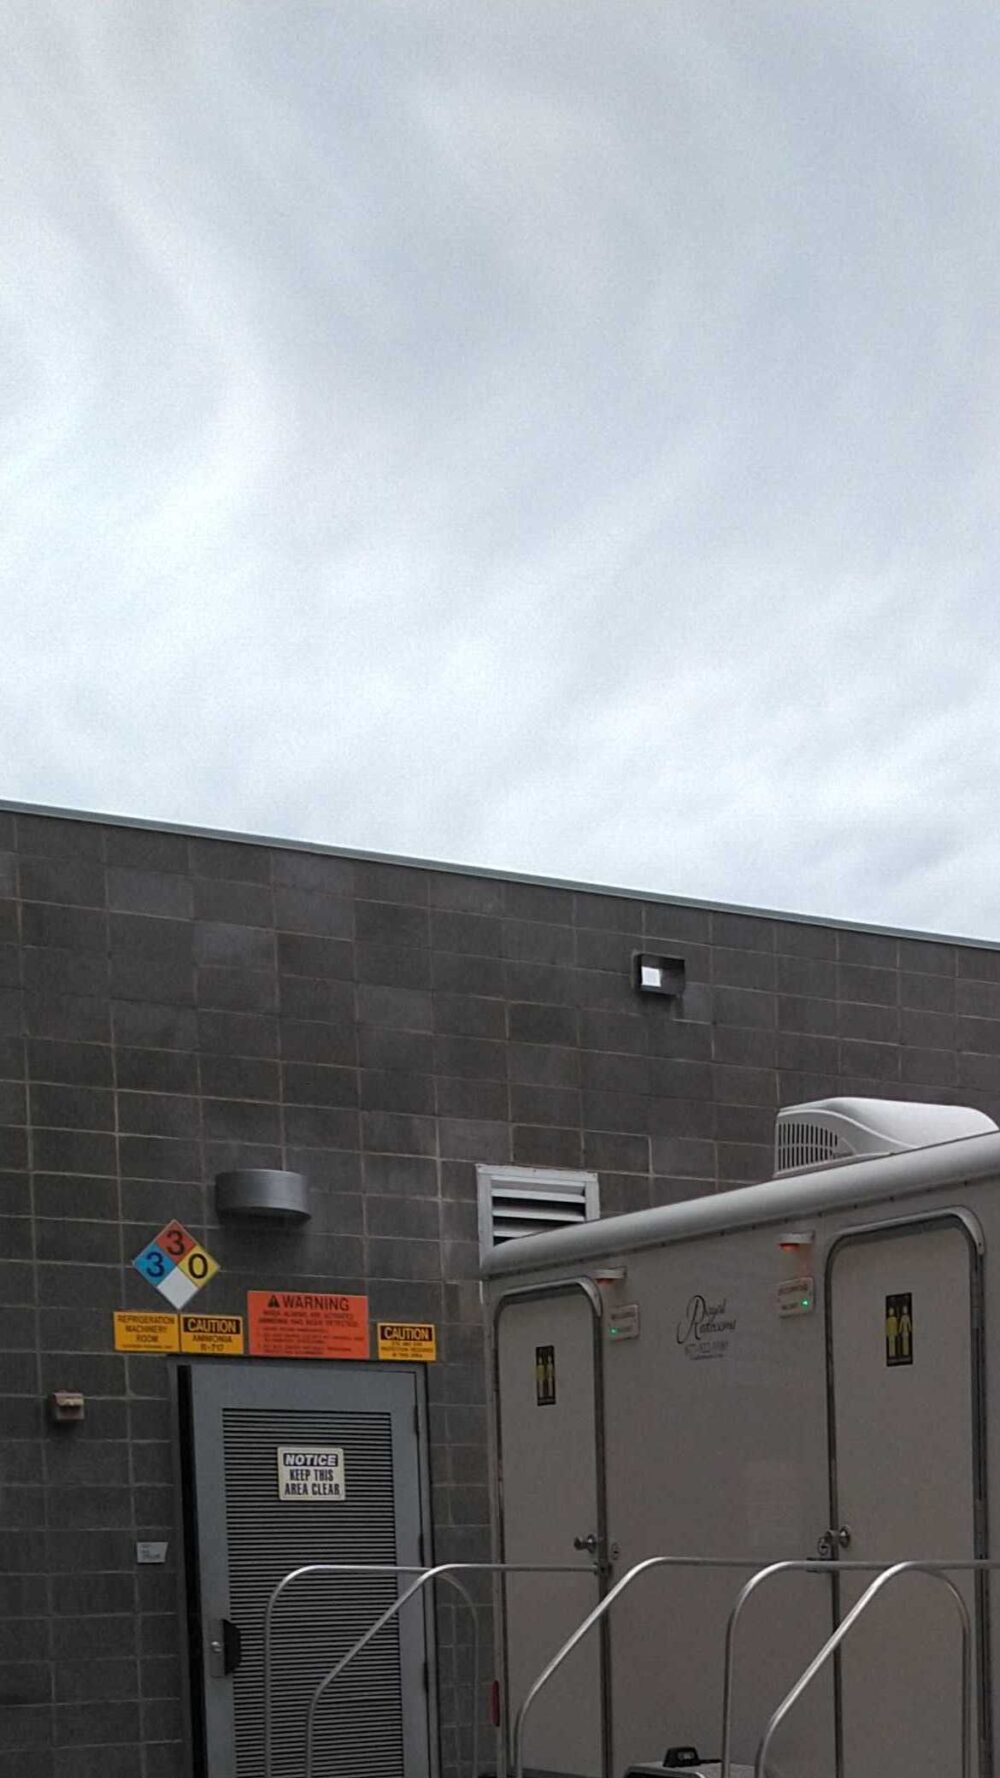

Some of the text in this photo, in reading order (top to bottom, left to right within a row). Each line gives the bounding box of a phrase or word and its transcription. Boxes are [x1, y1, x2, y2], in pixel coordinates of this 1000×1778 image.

[166, 1230, 184, 1255] 3
[147, 1252, 164, 1277] 3
[188, 1253, 208, 1279] 0
[282, 1294, 350, 1312] WARNING
[125, 1324, 168, 1333] MACHINERY
[187, 1318, 237, 1333] CAUTION
[136, 1334, 159, 1343] ROOM
[193, 1334, 232, 1343] AMMONIA
[384, 1326, 430, 1340] CAUTION
[285, 1453, 337, 1466] NOTICE
[290, 1469, 334, 1482] KEEP THIS
[285, 1482, 340, 1496] AREA CLEAR
